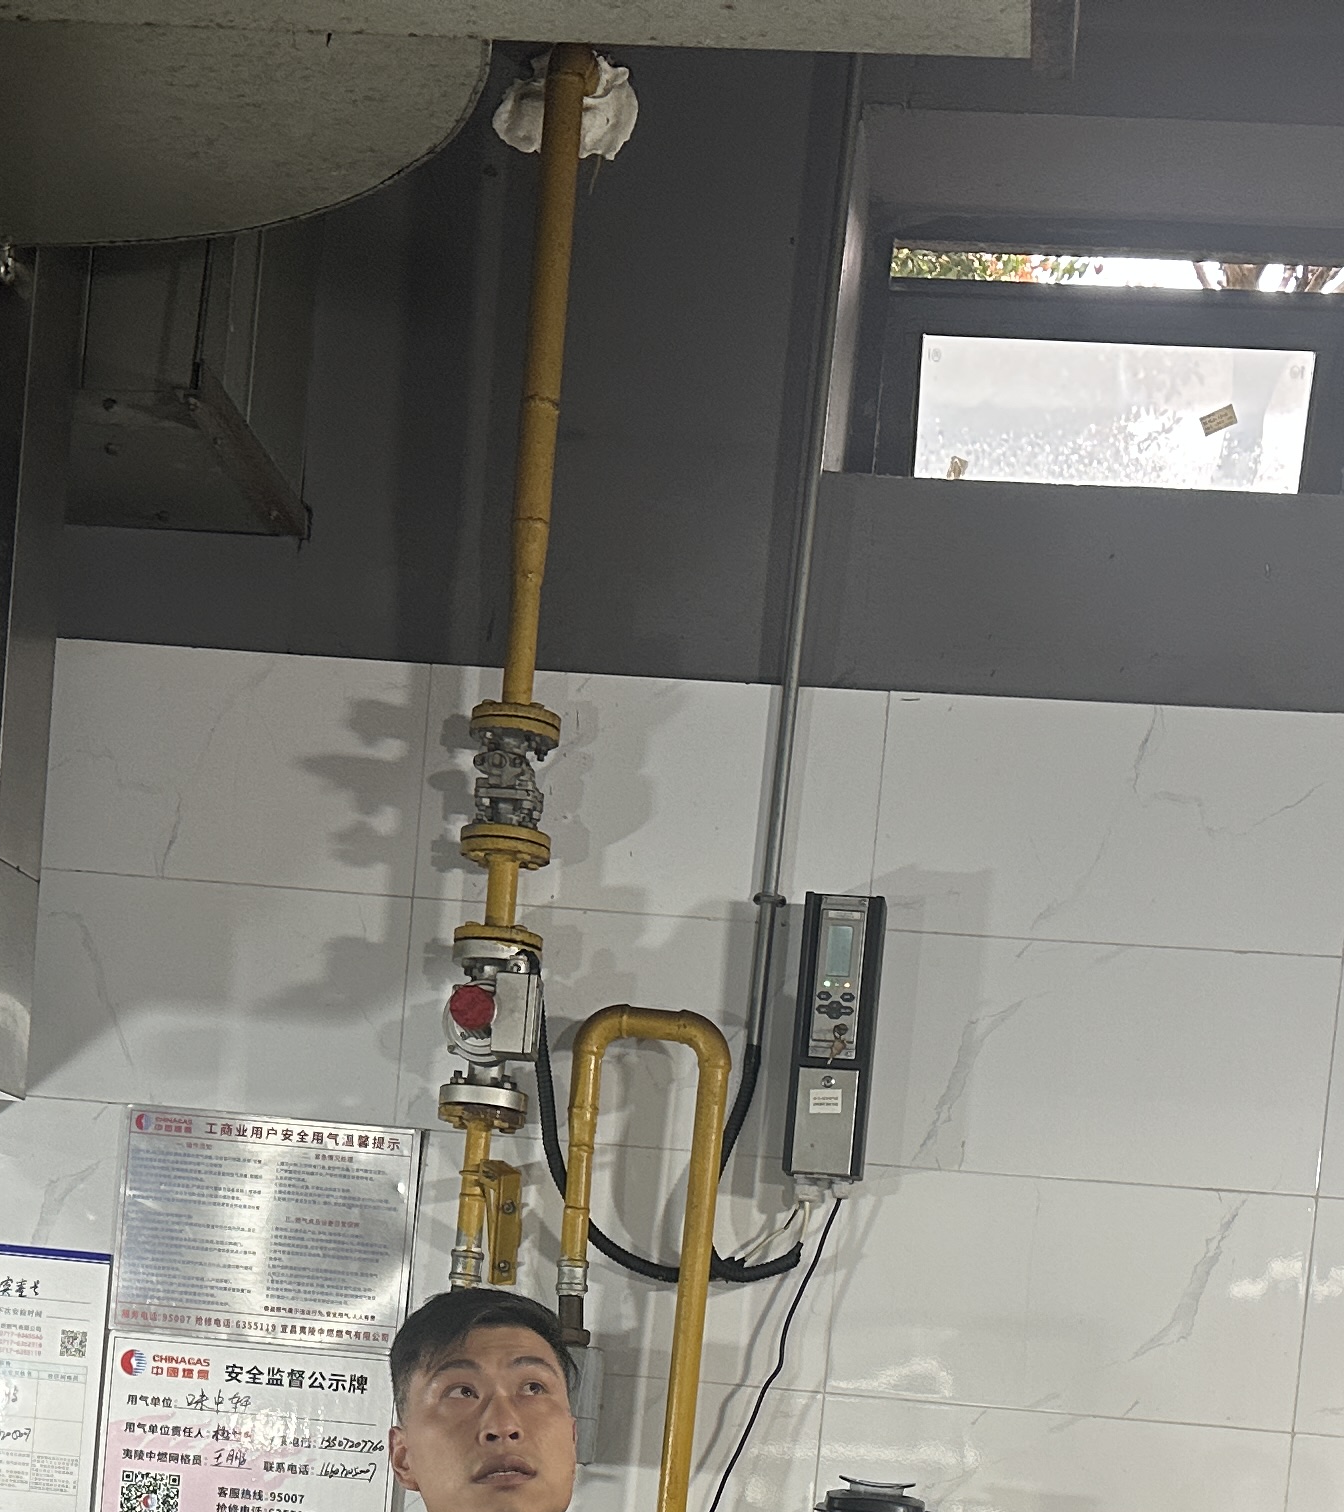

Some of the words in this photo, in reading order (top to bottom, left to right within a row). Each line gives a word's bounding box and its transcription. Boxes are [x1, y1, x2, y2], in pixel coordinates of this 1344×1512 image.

[204, 1122, 401, 1151] 工商业用户安全用气温馨提示
[224, 1364, 368, 1394] 安全监督公示牌
[217, 1486, 305, 1504] 客服热线:95007
